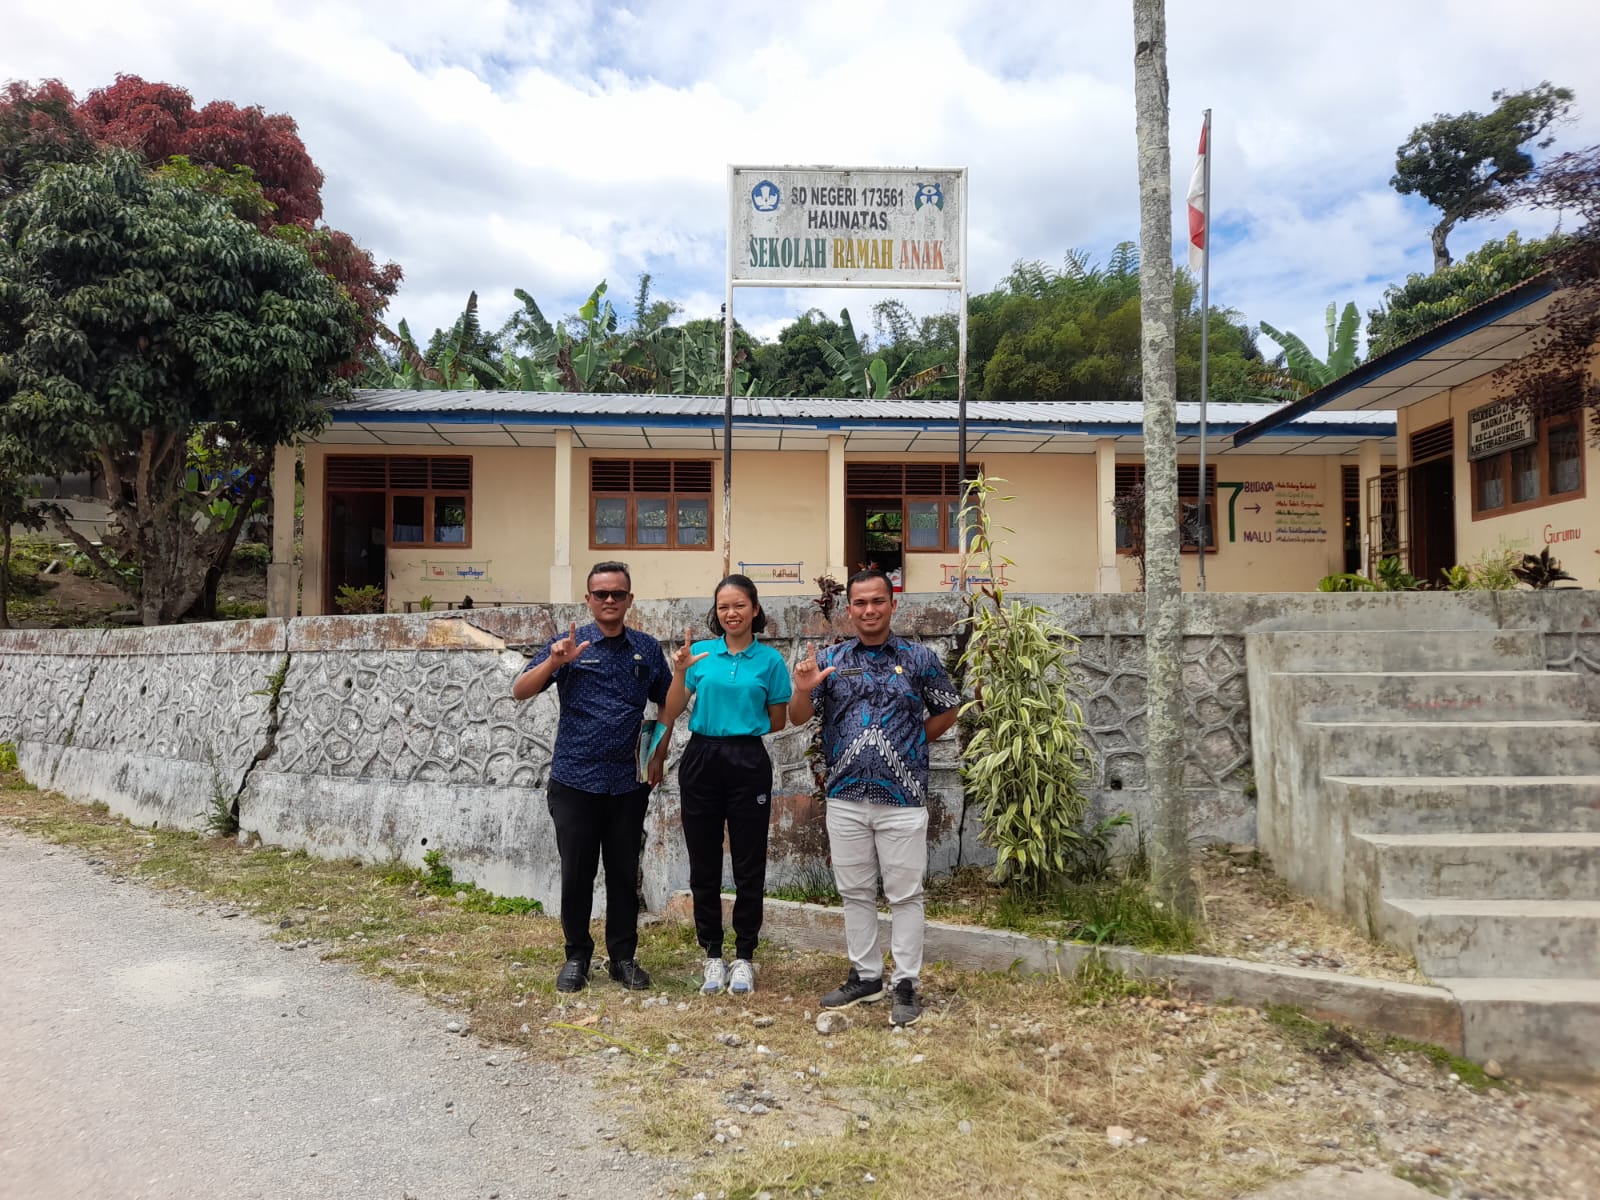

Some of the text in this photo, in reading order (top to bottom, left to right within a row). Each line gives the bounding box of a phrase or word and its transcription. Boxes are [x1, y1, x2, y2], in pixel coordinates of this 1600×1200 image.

[791, 187, 904, 207] SD NEGERI 173561
[808, 210, 888, 230] HAUNATAS
[750, 237, 945, 270] SEKOLAH RAMAH ANAK
[1244, 481, 1275, 492] BUDAYA
[1217, 482, 1244, 543] 7
[1243, 531, 1272, 543] MALU
[1543, 523, 1581, 544] Gurumu
